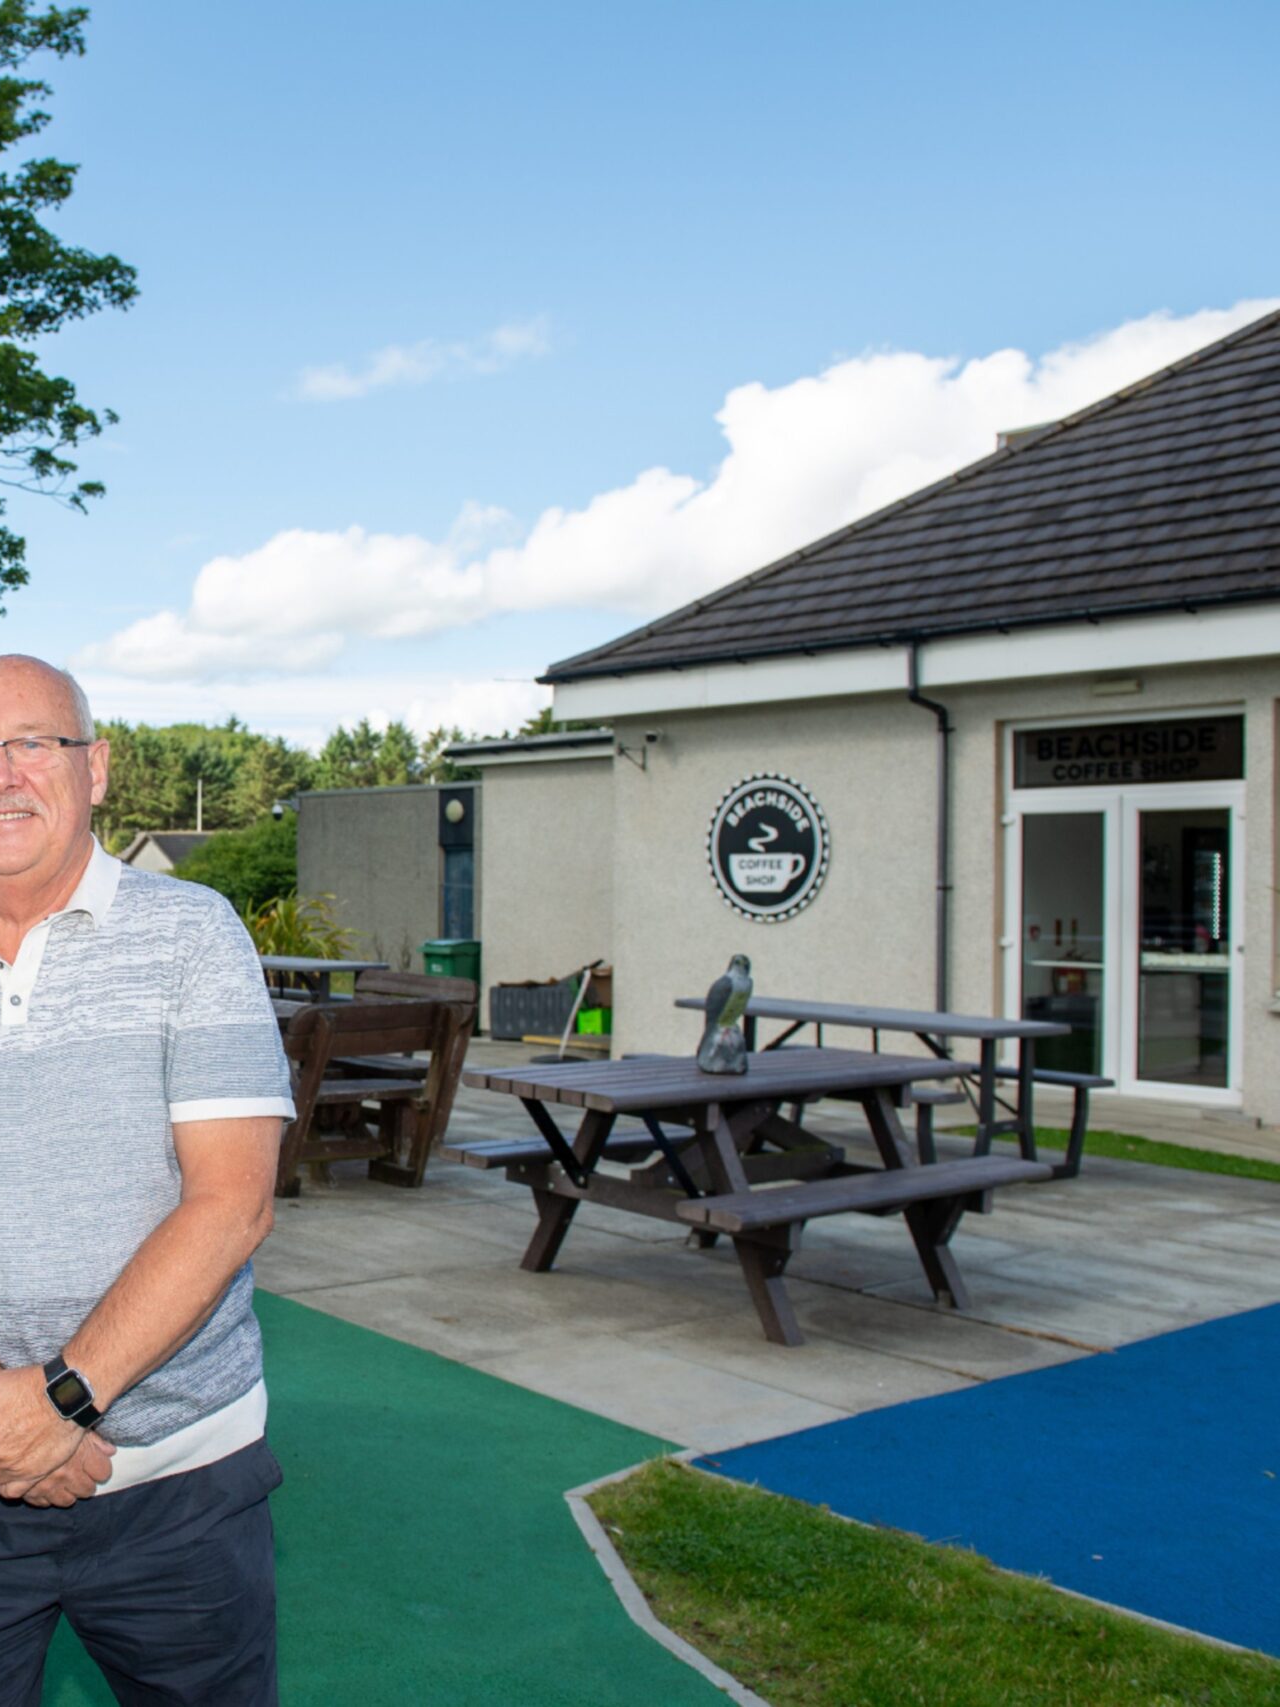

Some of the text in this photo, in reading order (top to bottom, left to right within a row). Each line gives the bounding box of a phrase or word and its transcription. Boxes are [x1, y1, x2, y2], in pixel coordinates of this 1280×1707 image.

[1037, 727, 1217, 761] BEACHSIDE
[1052, 757, 1199, 781] COFFEE SHOP
[726, 791, 810, 833] BEACHSIDE
[738, 858, 783, 870] COFFEE
[745, 875, 777, 886] SHOP
